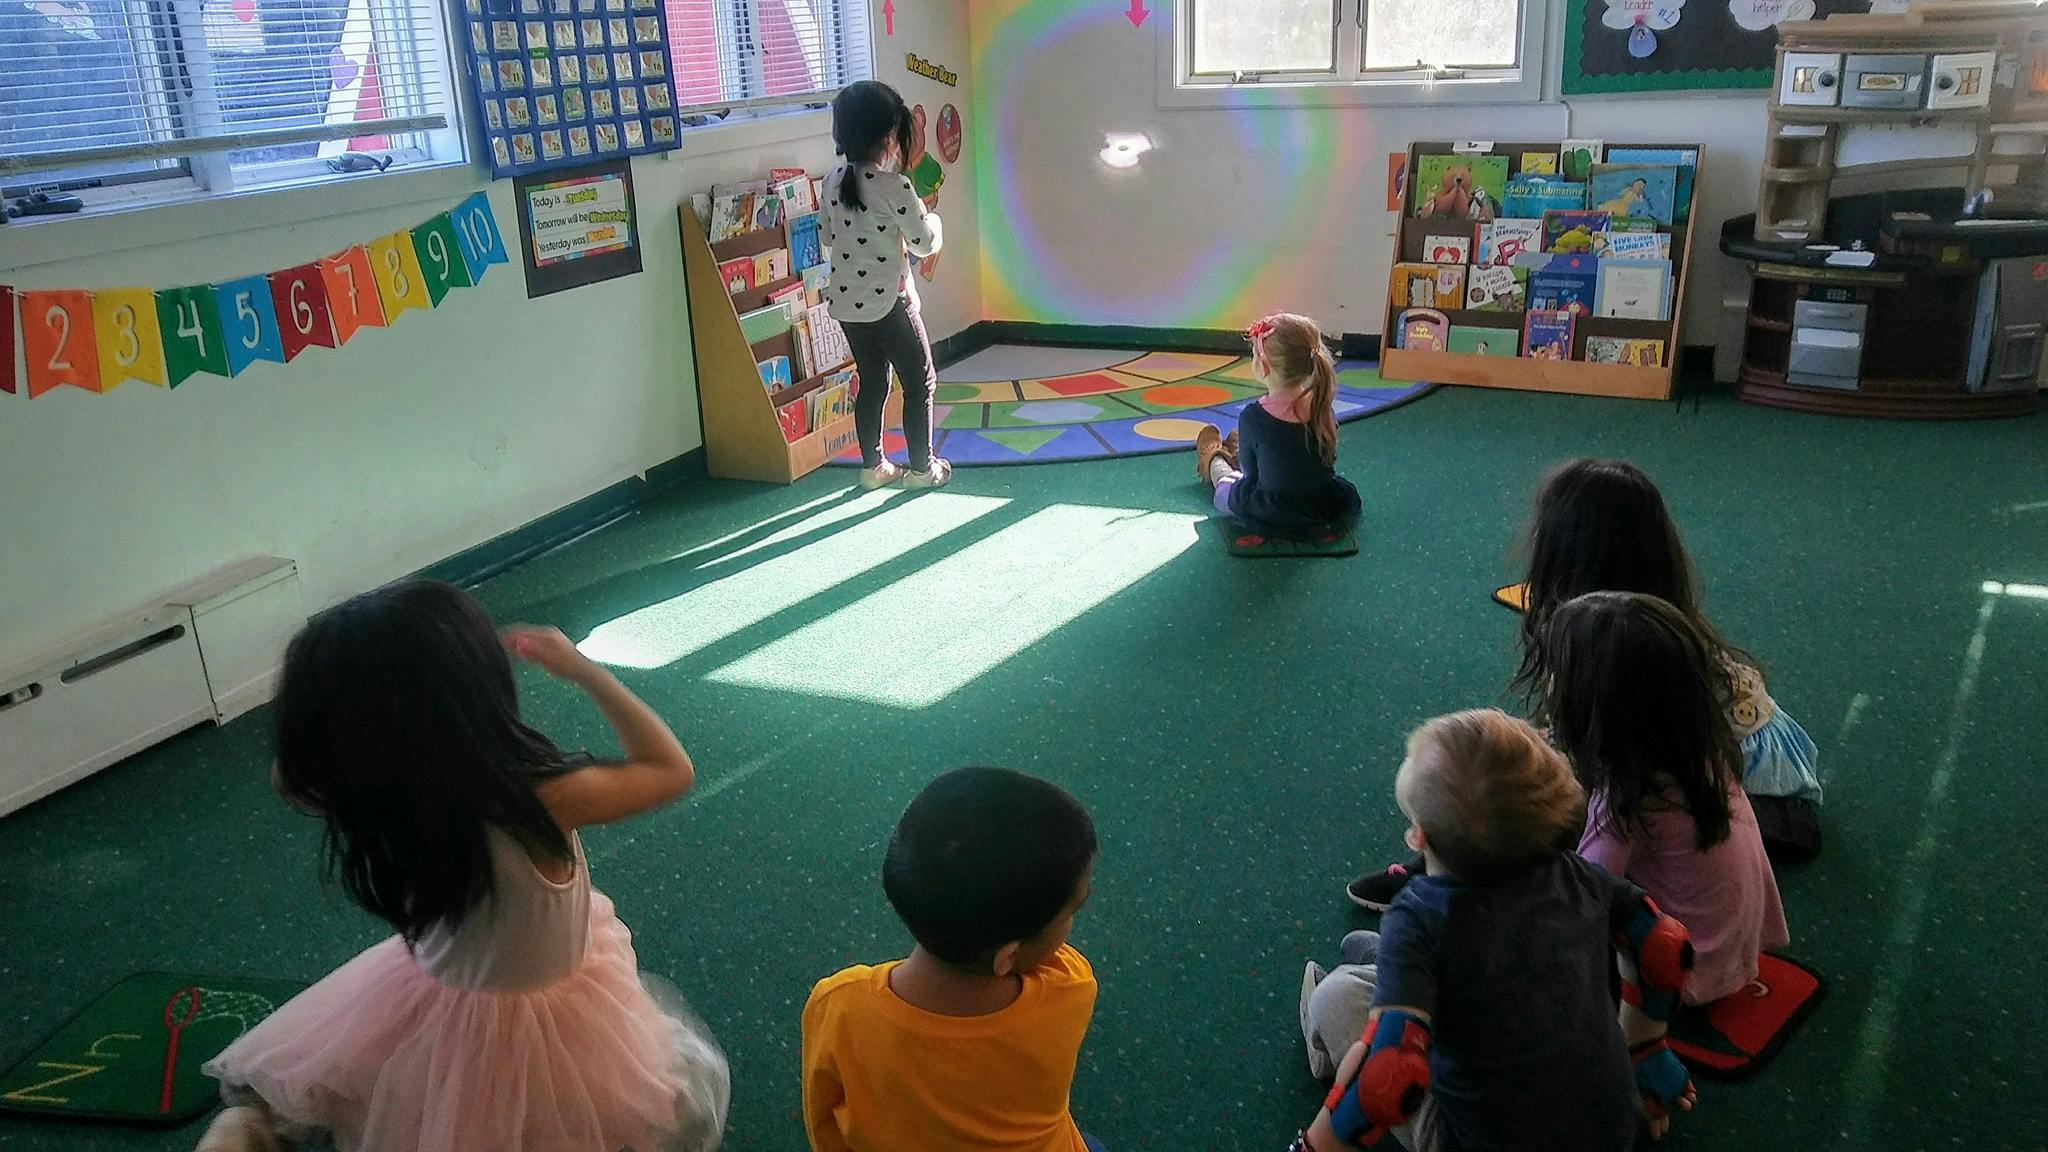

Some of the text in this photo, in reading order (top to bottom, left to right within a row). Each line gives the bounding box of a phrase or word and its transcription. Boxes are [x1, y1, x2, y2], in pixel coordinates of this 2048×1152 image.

[1752, 2, 1782, 17] helper
[906, 53, 958, 87] Weather Bear
[532, 188, 598, 209] Today is Tuesday
[535, 210, 631, 230] Tomorrow will be Wednesday
[538, 226, 616, 253] Yesterday was Monday
[1614, 237, 1631, 245] FIVE
[1615, 241, 1655, 252] MONKEYS
[45, 206, 494, 371] 2 3 4 5 6 7 8 9 10
